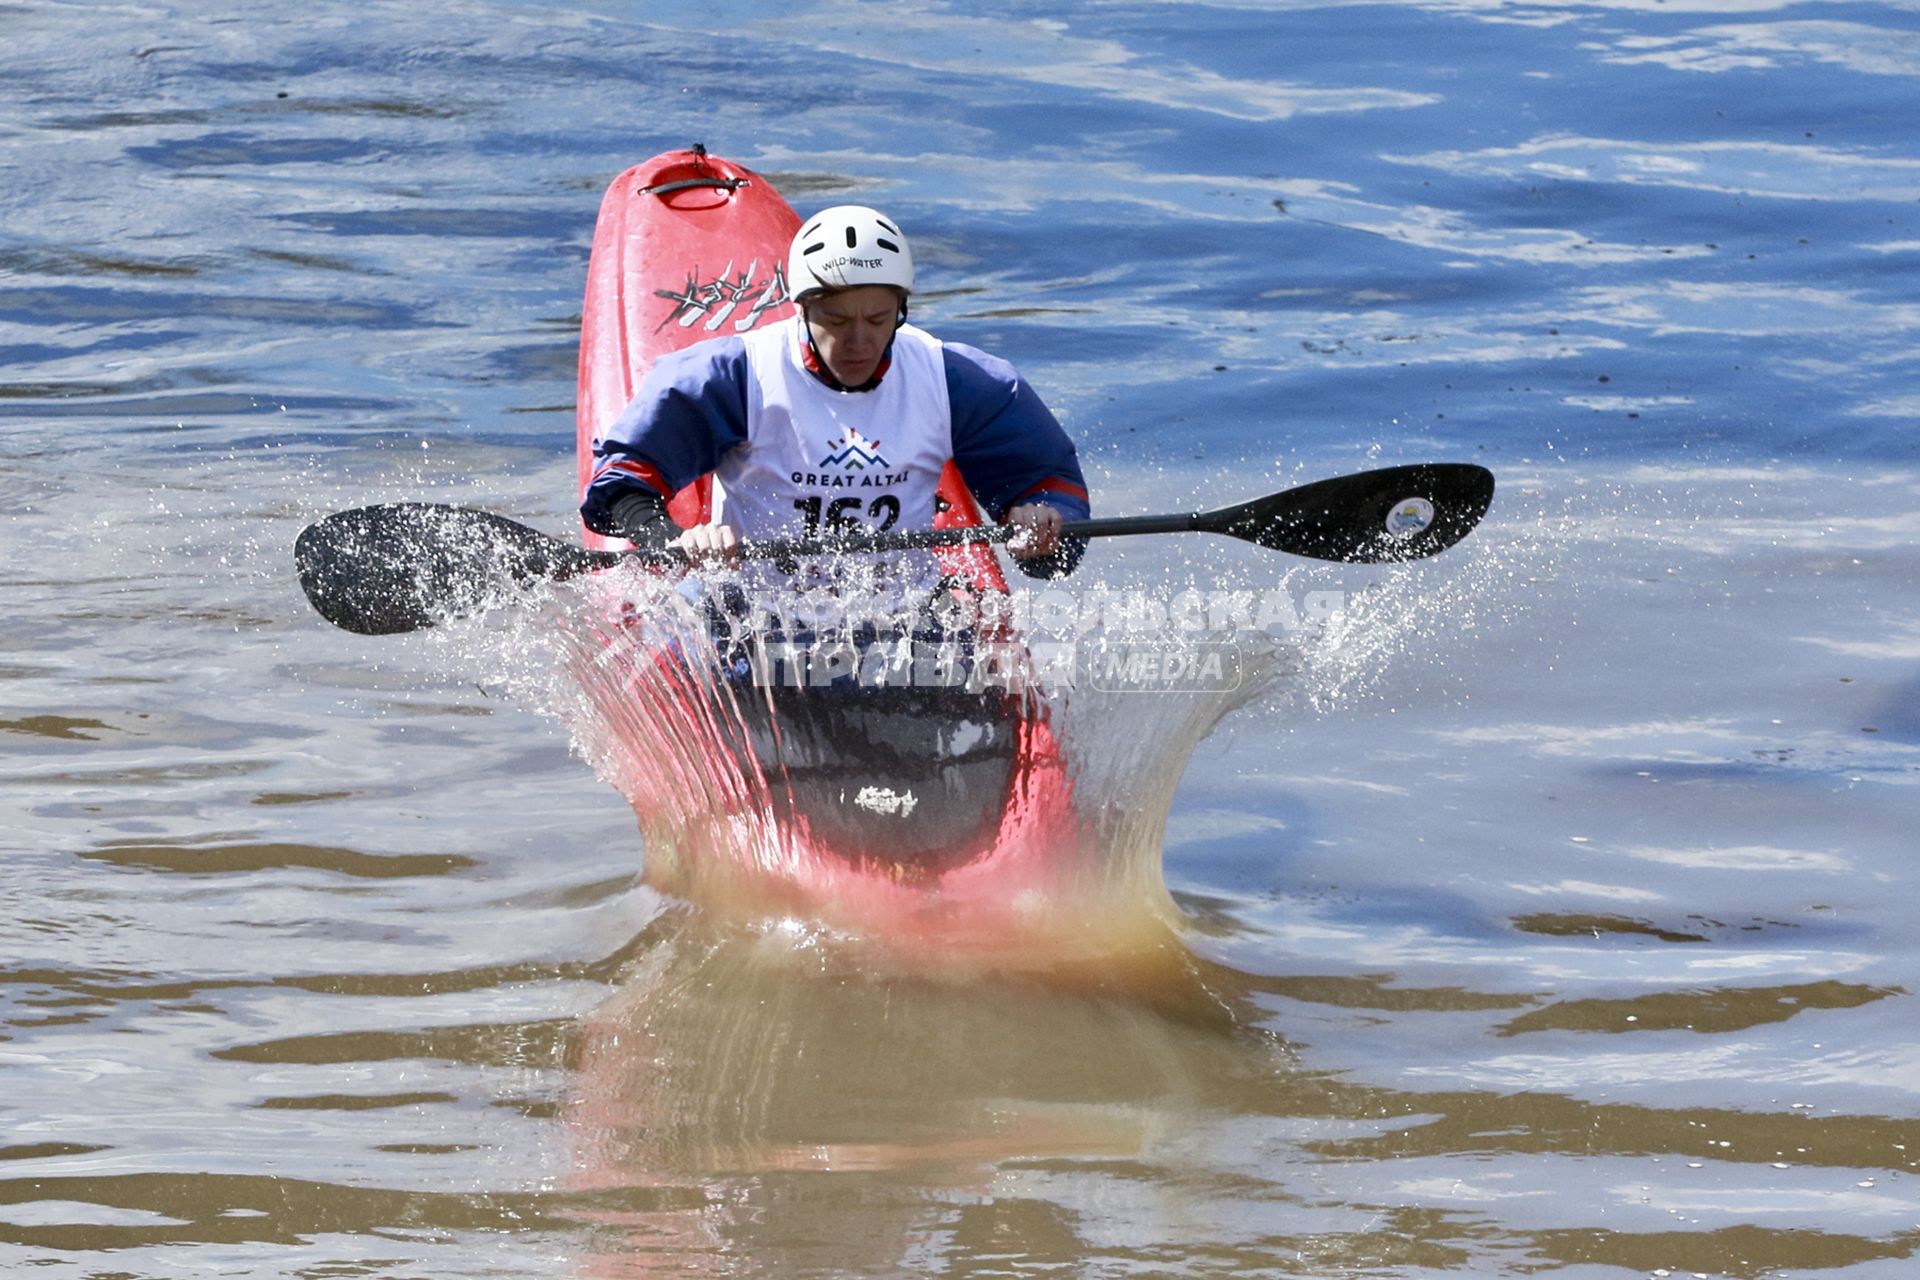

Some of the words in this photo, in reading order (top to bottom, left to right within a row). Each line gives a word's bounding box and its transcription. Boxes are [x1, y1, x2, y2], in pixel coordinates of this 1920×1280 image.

[822, 257, 882, 271] WILD-WATER
[791, 471, 855, 487] GREAT
[861, 470, 909, 487] ALTAI
[794, 494, 900, 538] 162
